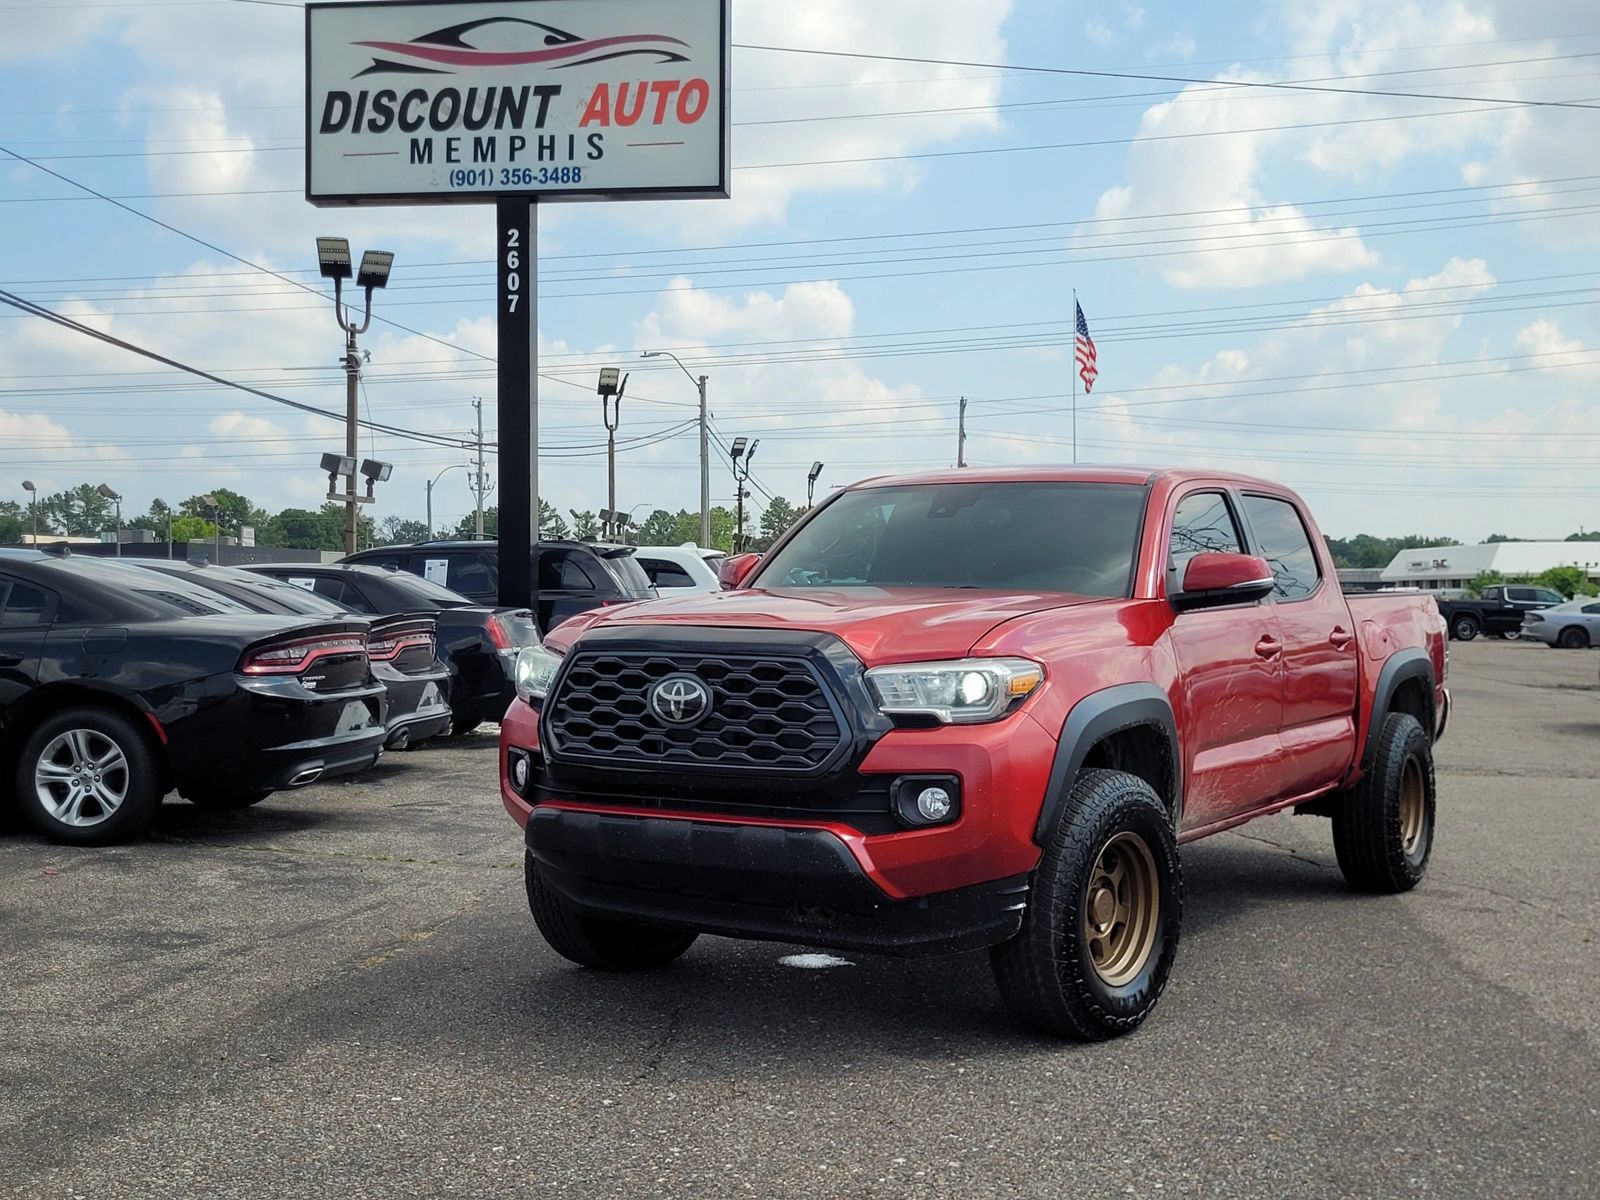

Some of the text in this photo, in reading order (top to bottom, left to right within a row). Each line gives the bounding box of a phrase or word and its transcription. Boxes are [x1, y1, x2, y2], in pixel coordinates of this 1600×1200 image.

[320, 78, 710, 134] DISCOUNT AUTO
[410, 133, 604, 165] MEMPHIS
[450, 166, 582, 188] (901) 356-3488
[507, 228, 520, 313] 2607
